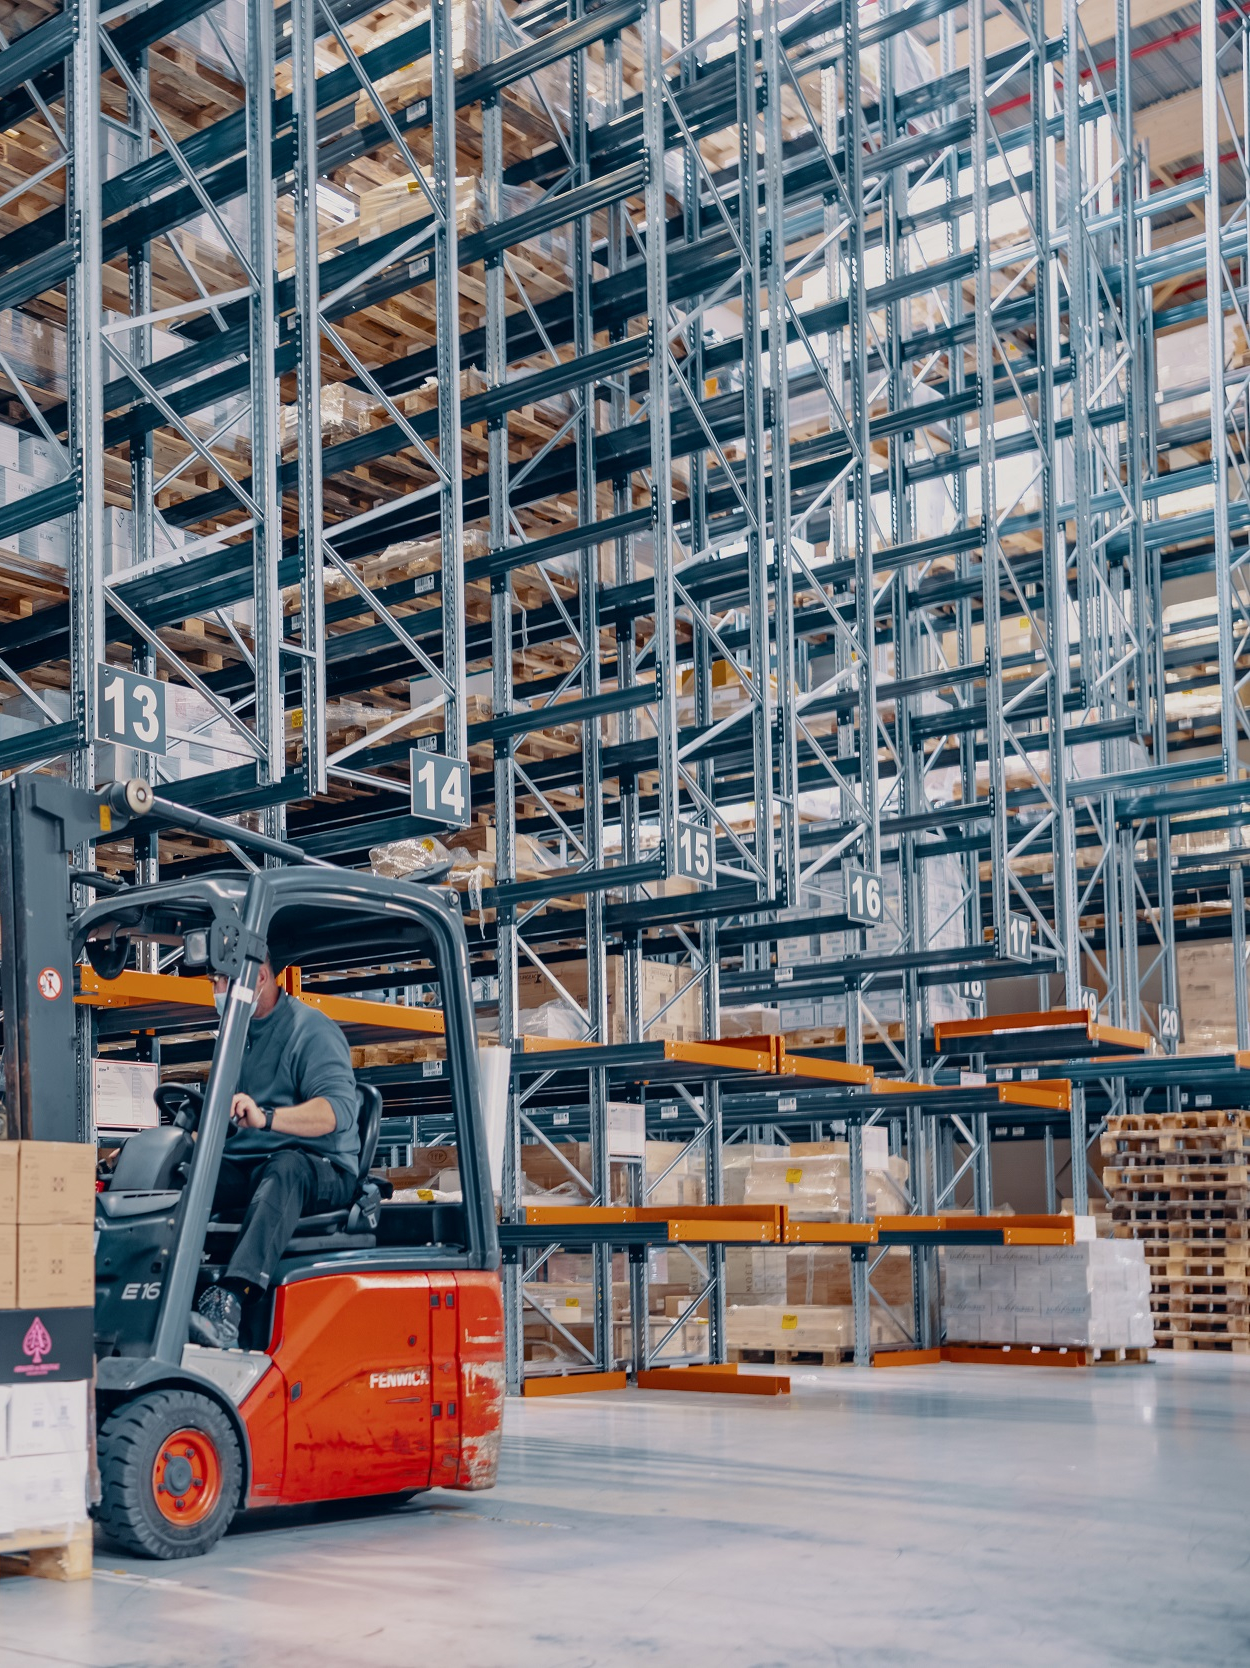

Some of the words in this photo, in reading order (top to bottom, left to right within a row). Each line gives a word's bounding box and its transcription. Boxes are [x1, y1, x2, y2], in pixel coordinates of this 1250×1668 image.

[104, 676, 160, 743] 13
[418, 760, 465, 817] 14
[680, 827, 710, 876] 15
[851, 875, 881, 919] 16
[1010, 917, 1029, 956] 17
[1082, 992, 1097, 1021] 19
[1161, 1008, 1178, 1037] 20
[369, 1370, 430, 1389] FENWICK
